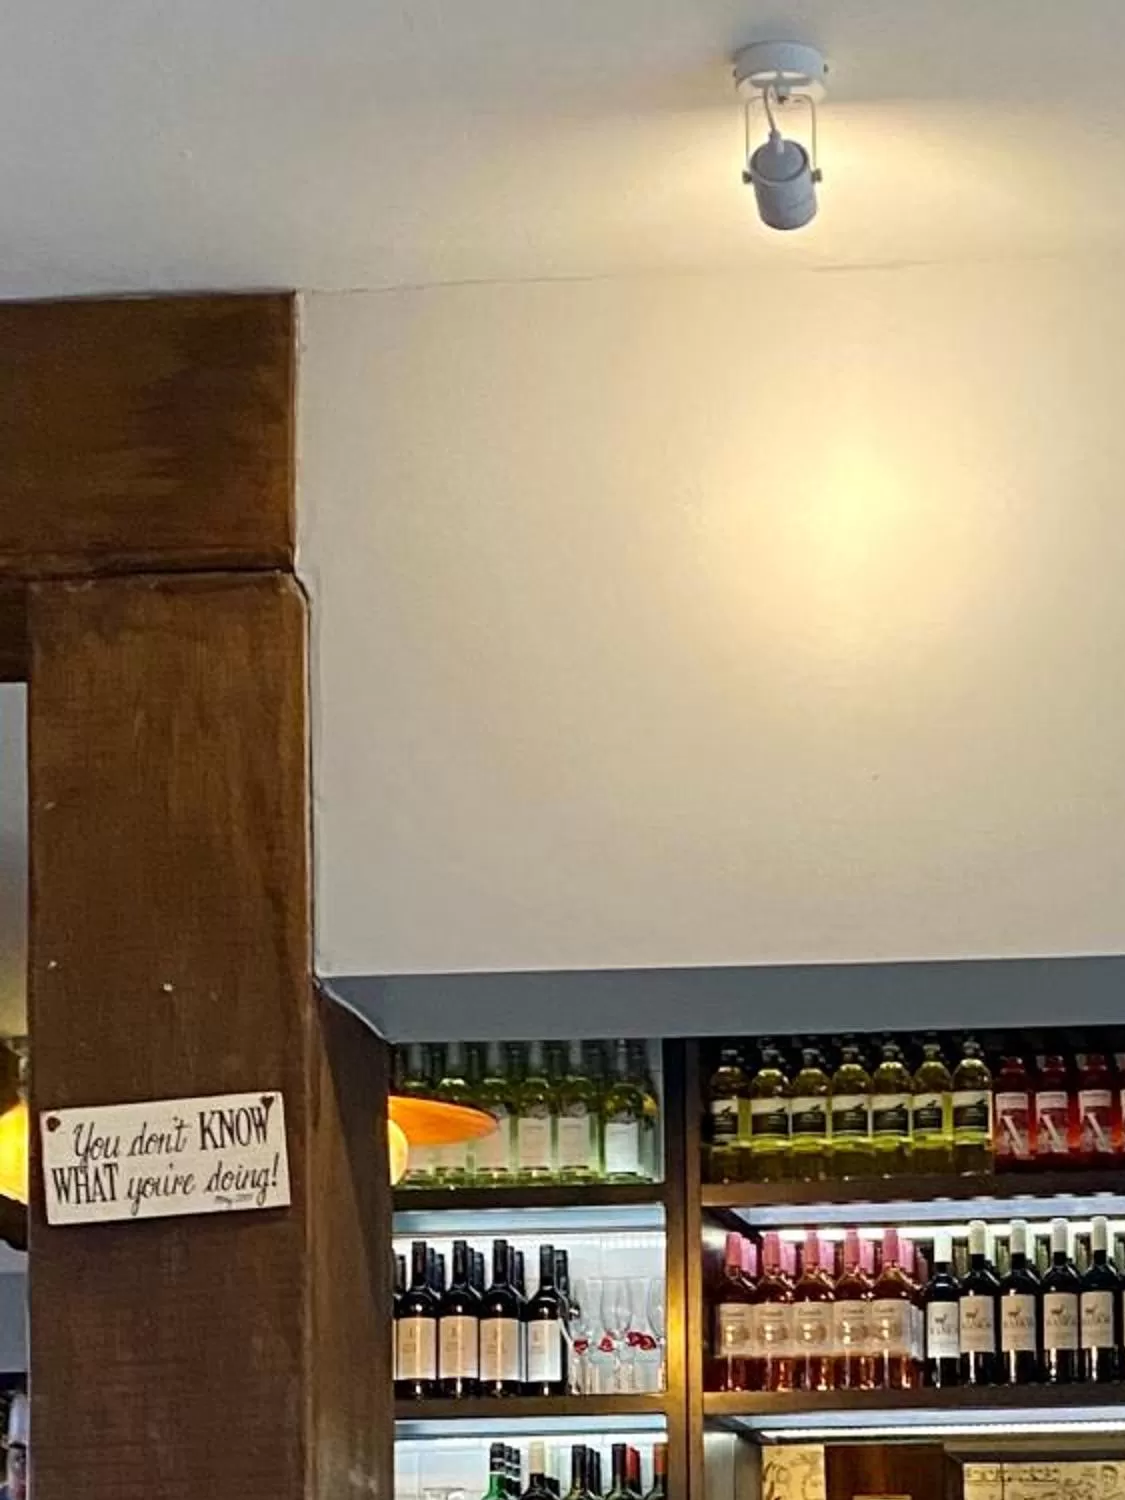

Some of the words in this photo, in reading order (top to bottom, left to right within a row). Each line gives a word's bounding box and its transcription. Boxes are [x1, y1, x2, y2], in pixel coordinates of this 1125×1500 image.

[73, 1121, 120, 1164] You
[198, 1106, 271, 1151] KNOW
[51, 1162, 119, 1205] WHAT
[205, 1151, 280, 1206] doing!
